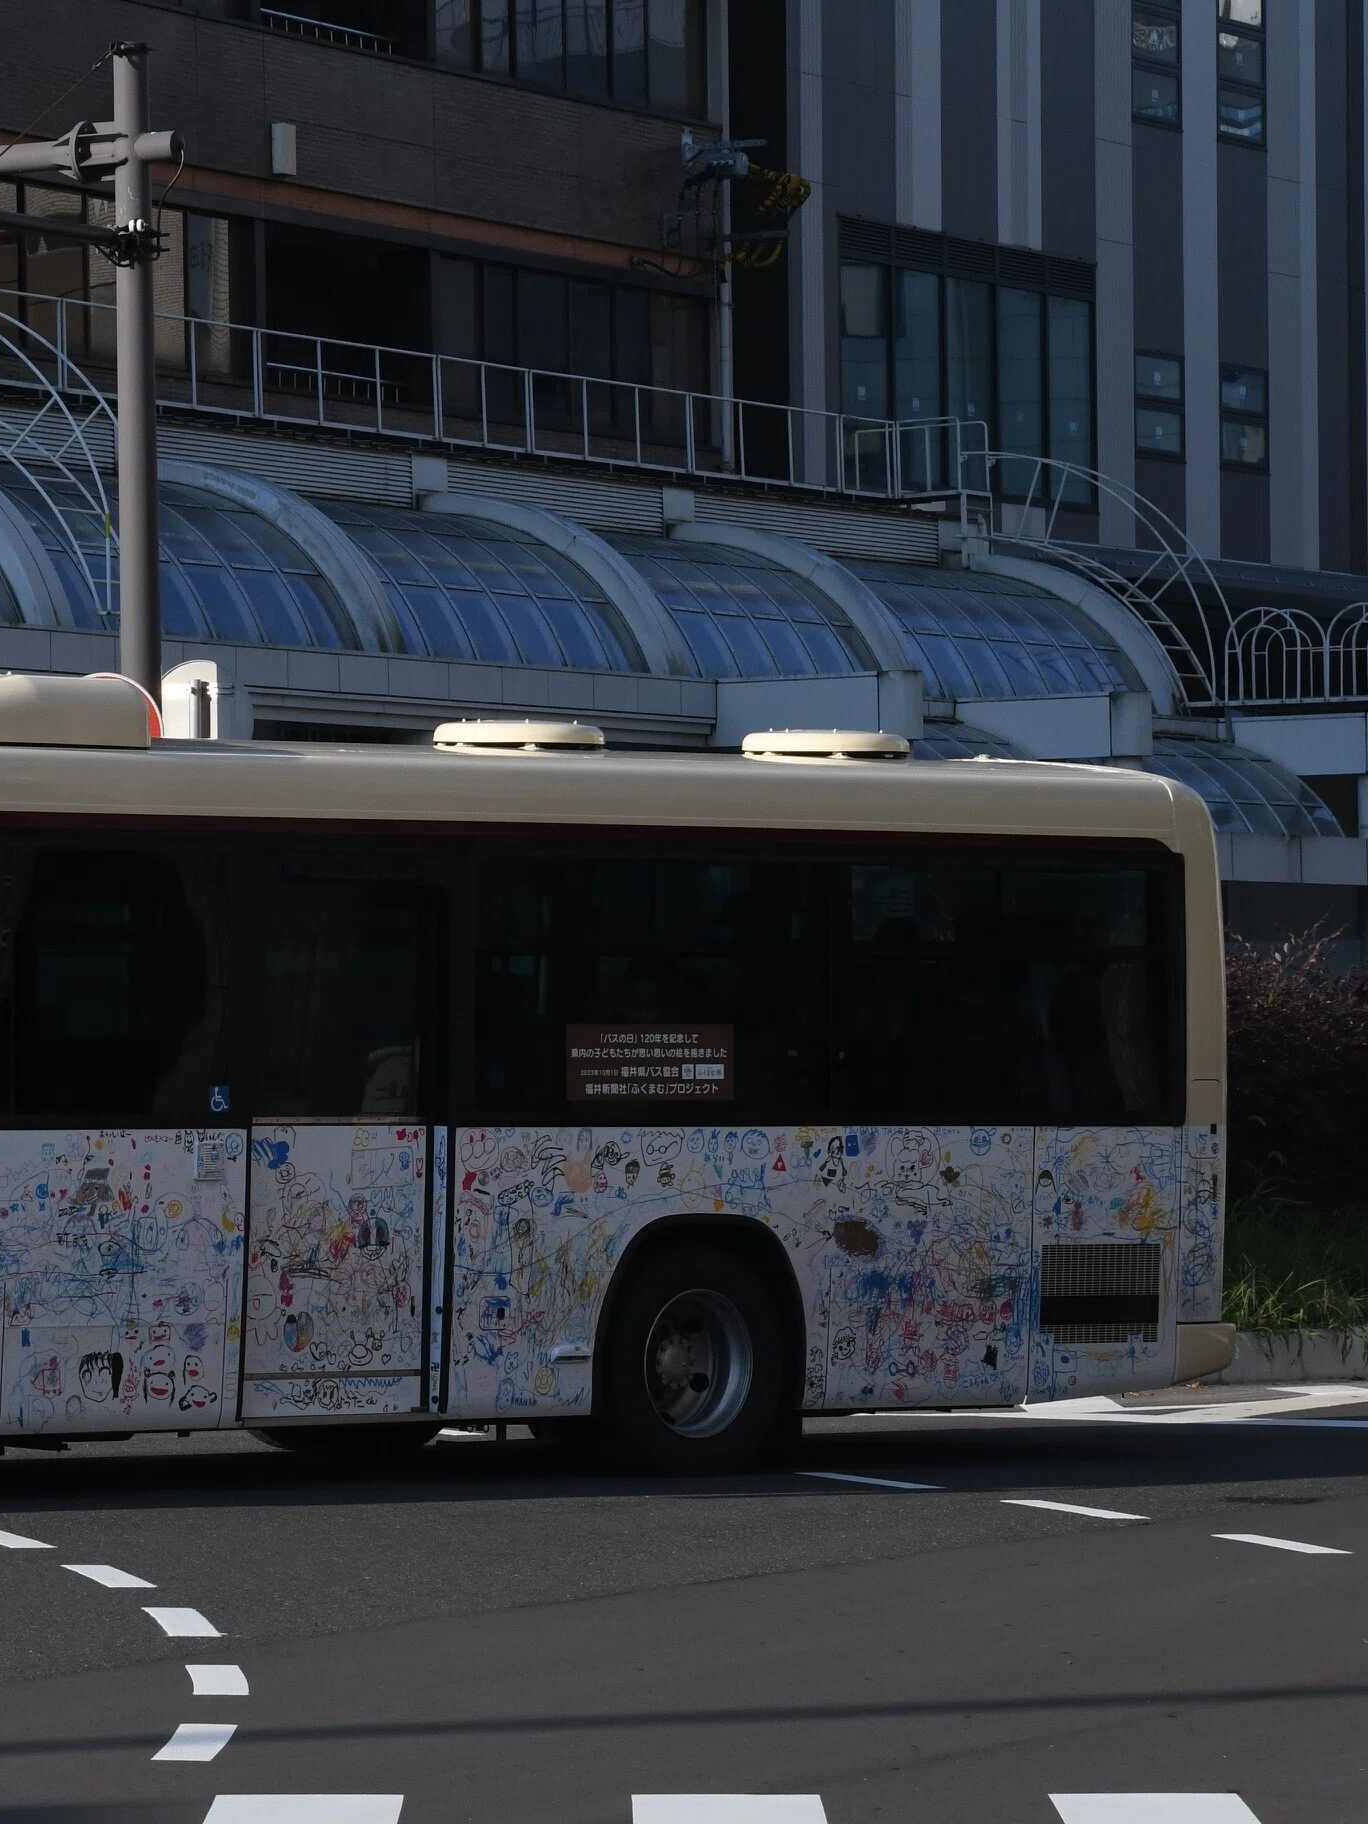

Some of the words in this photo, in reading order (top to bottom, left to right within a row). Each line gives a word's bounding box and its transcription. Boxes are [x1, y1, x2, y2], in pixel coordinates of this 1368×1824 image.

[570, 1048, 727, 1058] 県内の子どもたちが思い思いの絵を描きました
[620, 1066, 680, 1077] 福井県バス協会
[584, 1083, 719, 1095] 福井新聞社「ふくまむ」プロジェクト
